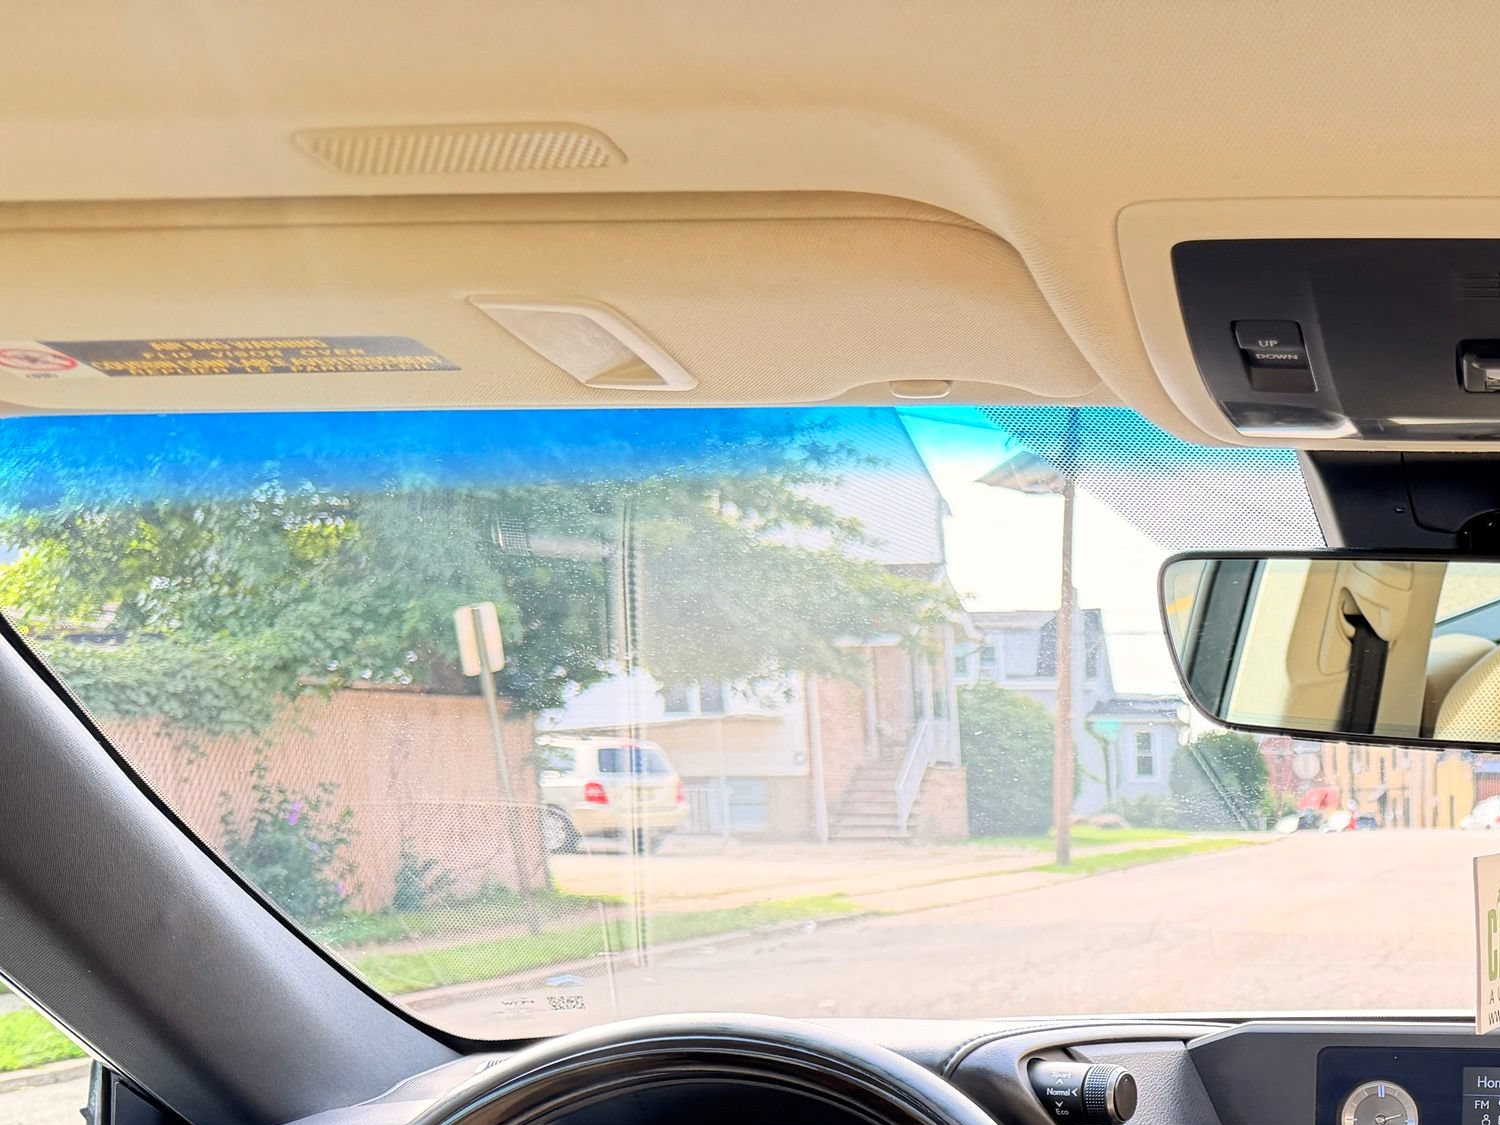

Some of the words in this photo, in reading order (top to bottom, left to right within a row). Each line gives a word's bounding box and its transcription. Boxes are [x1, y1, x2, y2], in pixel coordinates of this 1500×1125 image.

[1258, 339, 1278, 348] UP
[210, 350, 284, 358] VISOR
[300, 348, 366, 356] OVER
[1052, 1071, 1072, 1080] Sport
[1046, 1087, 1071, 1097] Normal
[1474, 1100, 1490, 1110] FM
[1055, 1108, 1070, 1116] Eco
